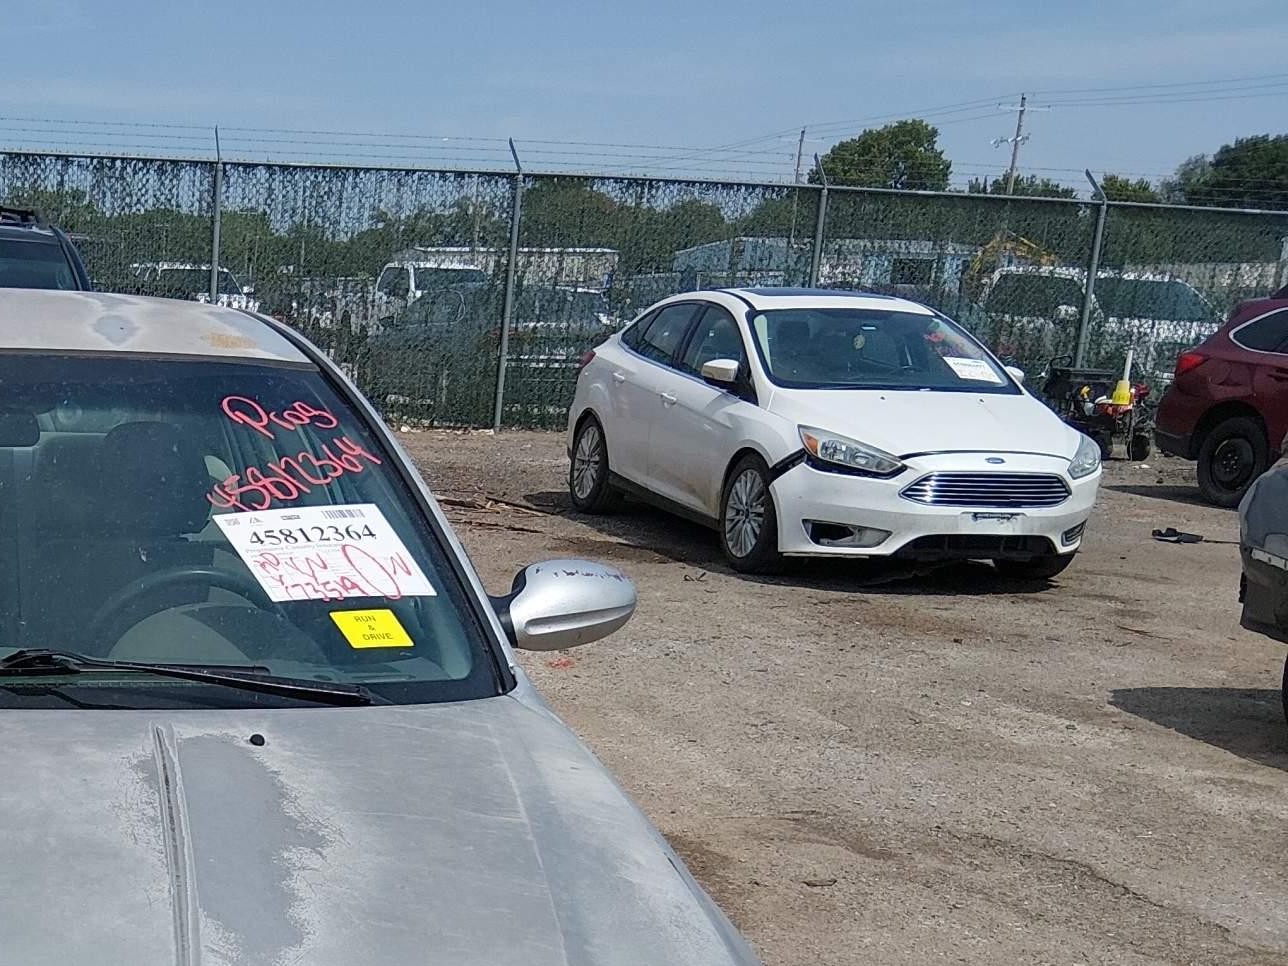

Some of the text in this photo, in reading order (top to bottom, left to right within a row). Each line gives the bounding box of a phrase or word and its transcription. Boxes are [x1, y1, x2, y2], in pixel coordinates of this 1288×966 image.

[206, 436, 383, 512] 45812364
[249, 523, 377, 546] 45812364
[353, 615, 377, 623] RUN
[367, 624, 376, 632] &
[362, 632, 394, 641] DRIVE
